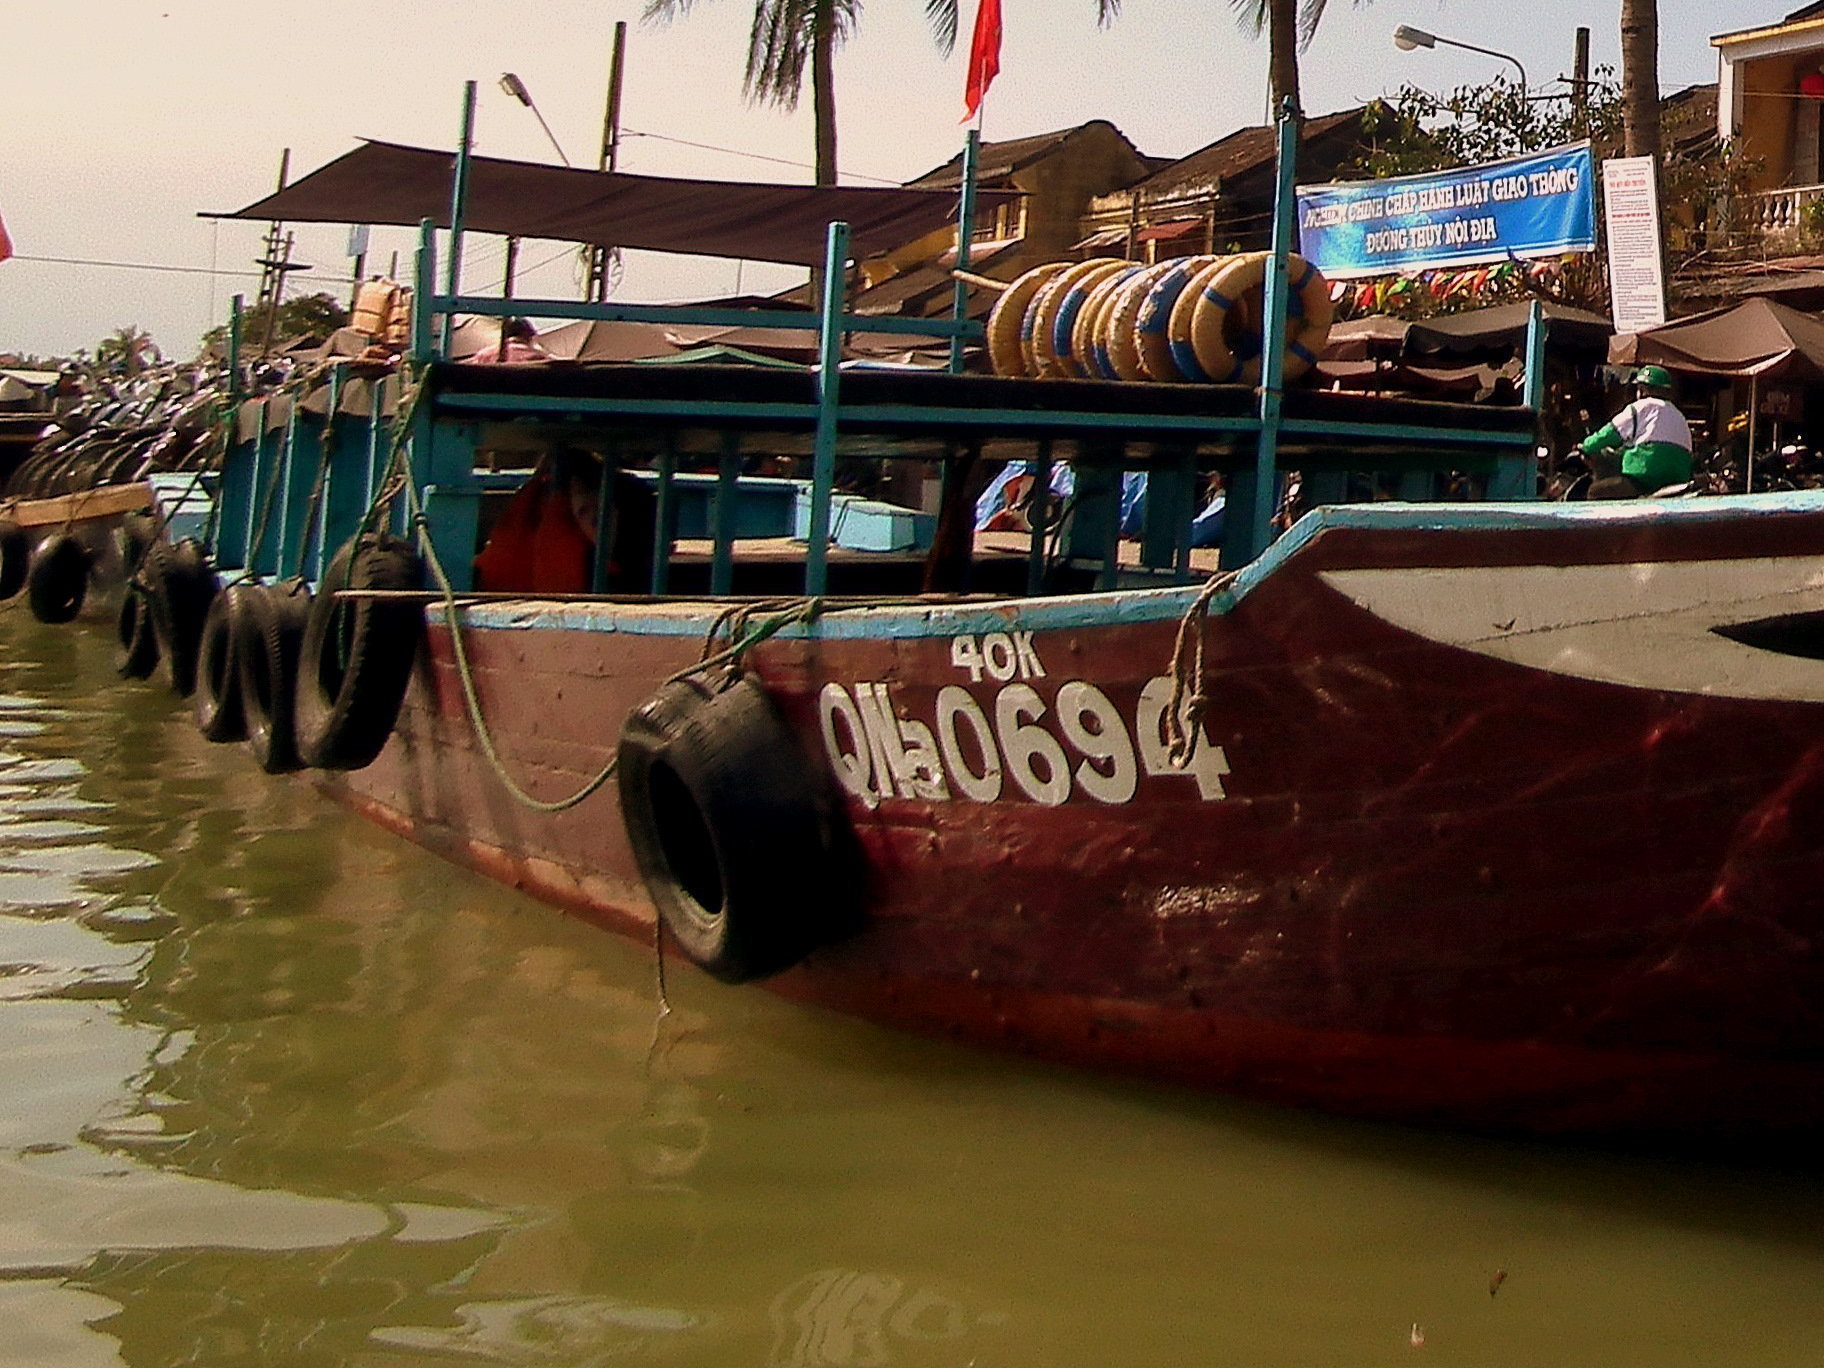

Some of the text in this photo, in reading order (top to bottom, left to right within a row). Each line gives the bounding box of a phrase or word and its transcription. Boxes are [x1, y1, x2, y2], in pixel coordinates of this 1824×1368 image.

[1456, 176, 1490, 208] LUẬT
[1492, 175, 1527, 201] GIAO
[1529, 165, 1578, 196] THÔNG
[1445, 215, 1469, 249] NỘI
[1470, 217, 1497, 245] ĐỊA
[951, 630, 1046, 682] 40K
